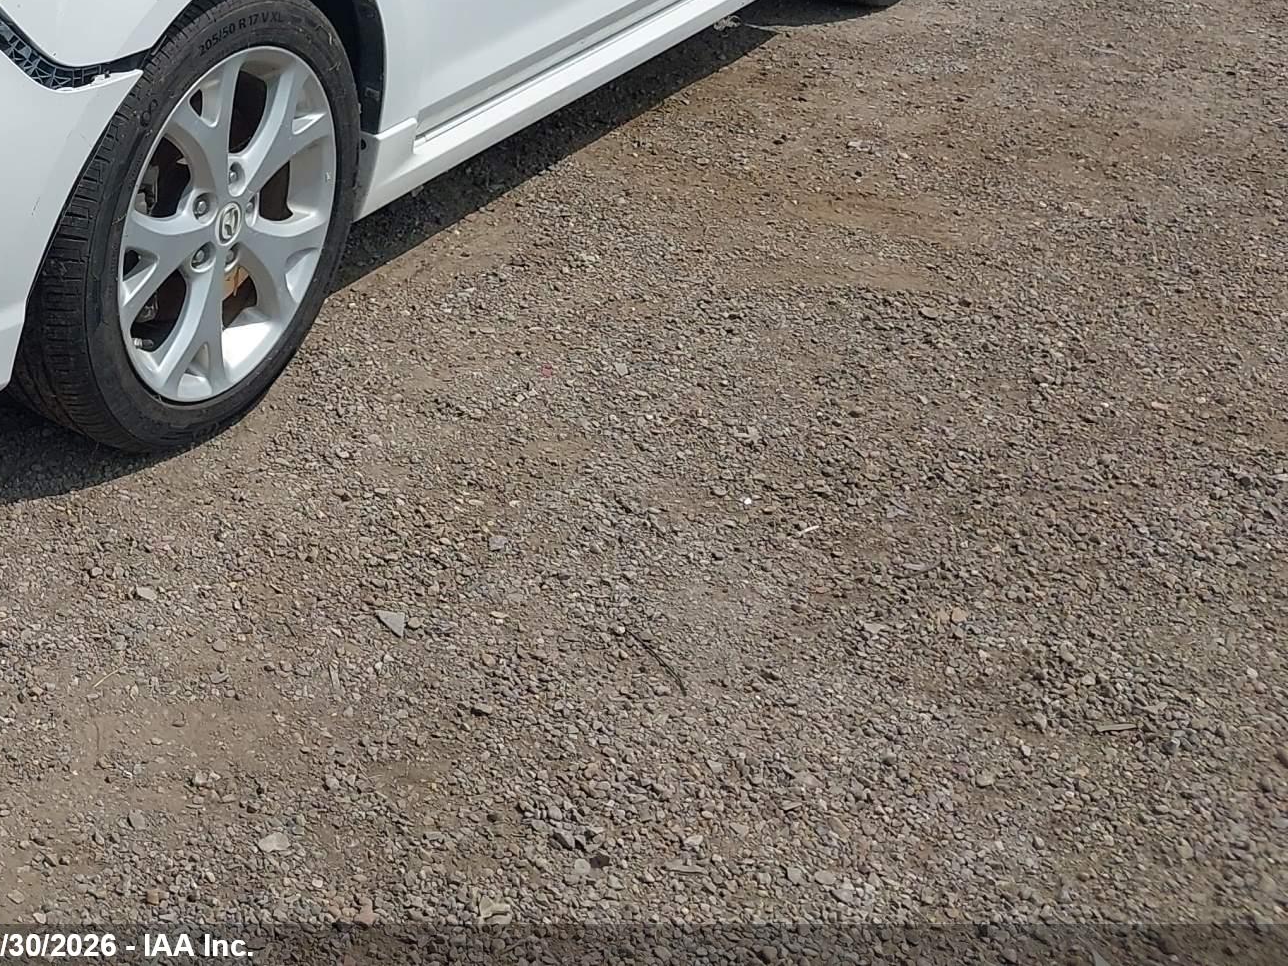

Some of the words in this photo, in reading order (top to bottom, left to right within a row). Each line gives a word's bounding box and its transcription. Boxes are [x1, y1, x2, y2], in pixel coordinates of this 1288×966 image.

[198, 22, 236, 57] 205/50
[238, 17, 247, 30] R
[248, 13, 259, 26] 17
